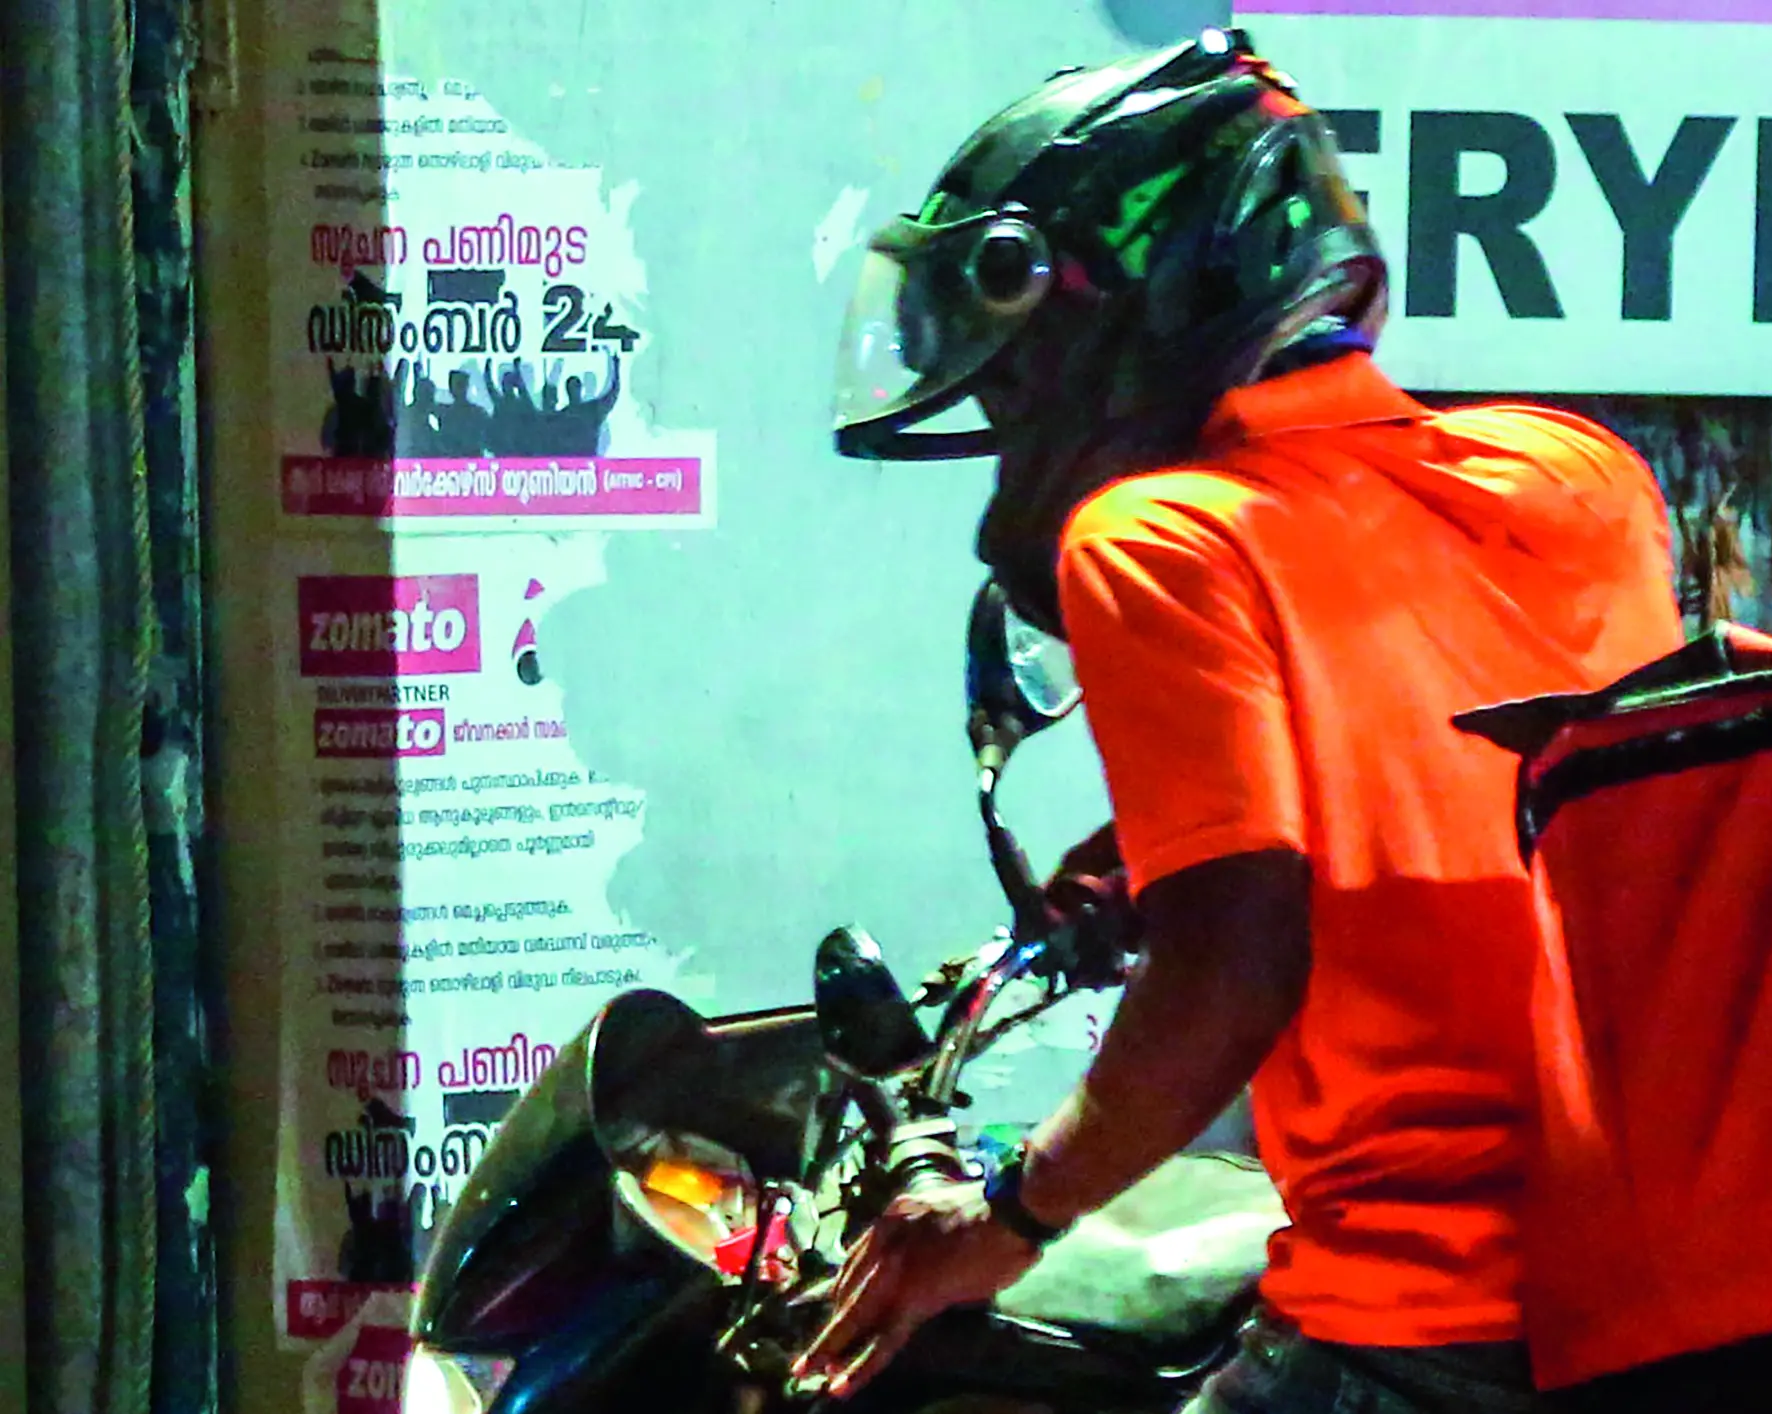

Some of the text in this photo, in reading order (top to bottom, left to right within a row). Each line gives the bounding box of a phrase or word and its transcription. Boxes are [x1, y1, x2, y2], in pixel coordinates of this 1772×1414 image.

[309, 224, 407, 274] സൂചന
[541, 284, 641, 353] 24
[309, 590, 466, 652] zomato
[318, 713, 440, 750] zomato
